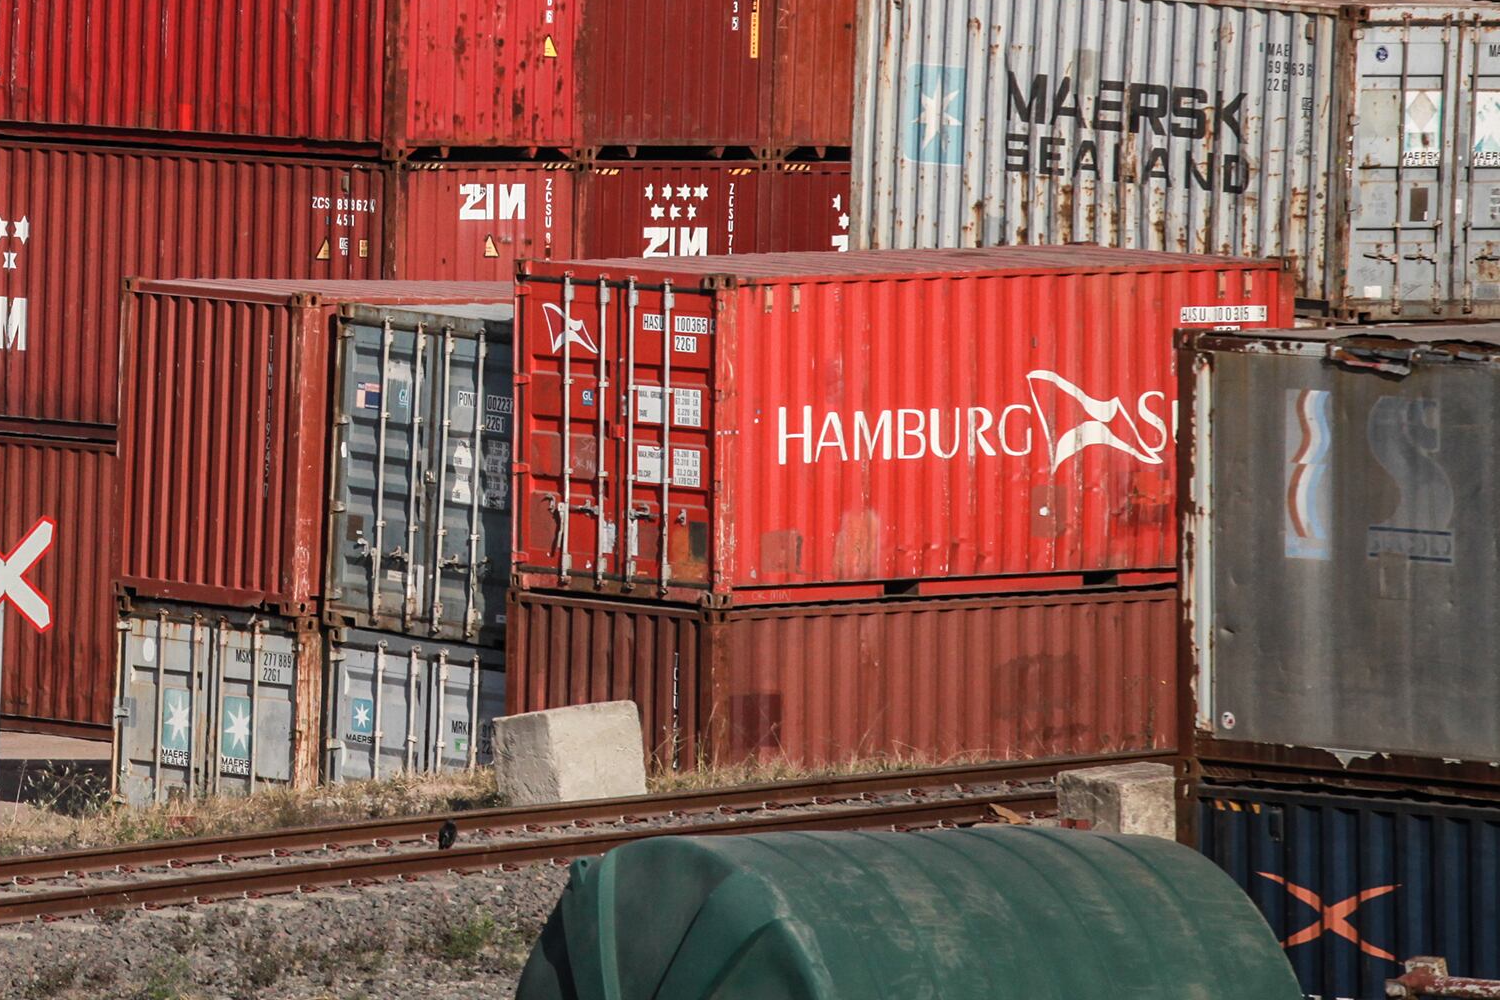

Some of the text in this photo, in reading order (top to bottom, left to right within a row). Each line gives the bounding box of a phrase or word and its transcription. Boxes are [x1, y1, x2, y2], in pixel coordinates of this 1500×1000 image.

[1007, 70, 1248, 144] MAERSK
[1005, 133, 1250, 195] SEALAND
[459, 183, 526, 220] ZIM
[545, 178, 553, 229] ZCSU
[643, 226, 708, 259] ZIM
[643, 314, 665, 330] HASU
[675, 317, 708, 333] 100365
[675, 336, 697, 351] 22G1
[582, 389, 593, 401] GL
[486, 416, 505, 432] 22G1
[778, 404, 1032, 465] HAMBURG
[263, 667, 281, 682] 22G1
